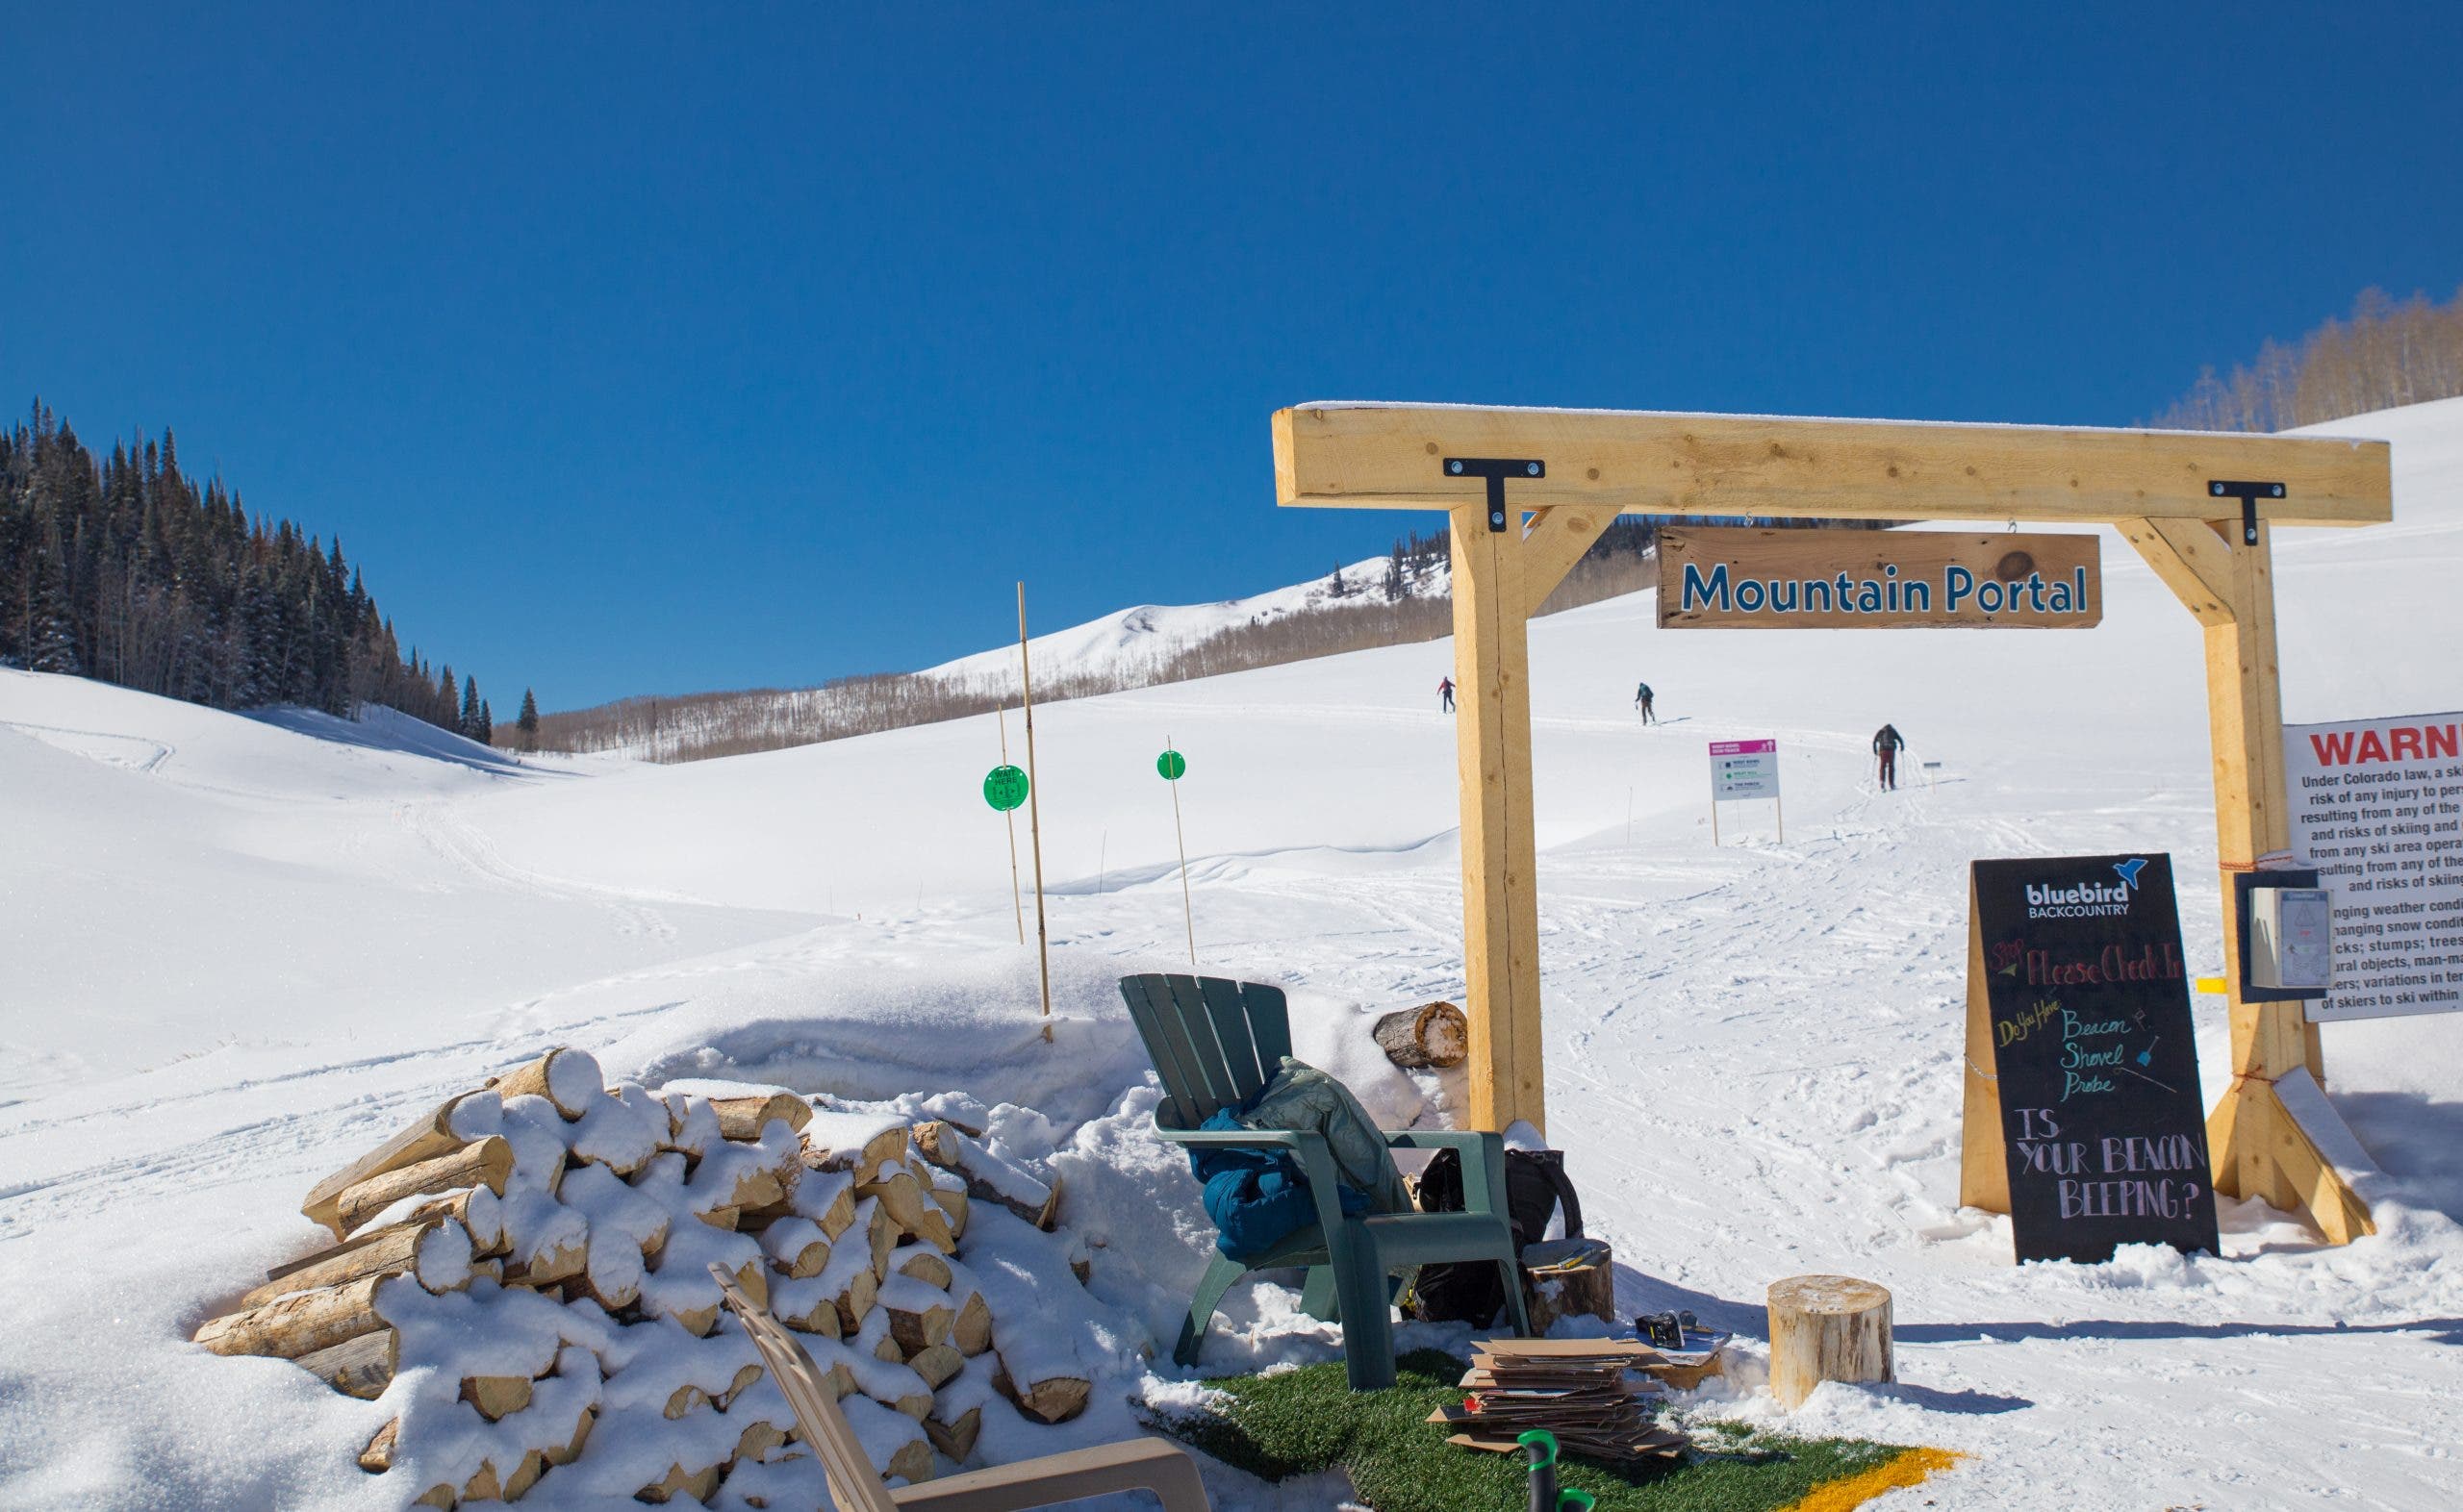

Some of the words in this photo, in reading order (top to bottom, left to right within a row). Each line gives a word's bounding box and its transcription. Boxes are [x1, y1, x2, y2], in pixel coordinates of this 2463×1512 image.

[1681, 563, 1931, 613] Mountain
[1944, 566, 2087, 614] Portal
[2310, 722, 2463, 767] WARN
[995, 769, 1015, 778] WAIT
[995, 777, 1017, 786] HERE
[2301, 775, 2339, 788] Under
[2344, 770, 2400, 785] Colorado
[2404, 769, 2431, 781] law,
[2434, 769, 2443, 778] a
[2310, 794, 2334, 805] risk
[2339, 791, 2351, 803] of
[2355, 791, 2377, 803] any
[2382, 787, 2419, 801] injury
[2423, 786, 2436, 797] to
[2301, 809, 2357, 824] resulting
[2361, 805, 2392, 819] from
[2396, 805, 2419, 819] any
[2423, 802, 2436, 815] of
[2439, 802, 2460, 814] the
[2311, 828, 2335, 841] and
[2339, 825, 2371, 840] risks
[2374, 823, 2388, 837] of
[2391, 821, 2430, 835] skiing
[2434, 819, 2458, 831] and
[2310, 846, 2340, 859] from
[2344, 845, 2366, 859] any
[2371, 842, 2390, 854] ski
[2394, 842, 2422, 853] area
[2317, 862, 2363, 876] sulting
[2367, 861, 2398, 873] from
[2401, 859, 2424, 871] any
[2427, 856, 2441, 869] of
[2444, 855, 2463, 868] the
[2026, 880, 2129, 905] bluebird
[2349, 879, 2373, 892] and
[2376, 876, 2409, 890] risks
[2412, 874, 2425, 887] of
[2029, 904, 2129, 919] BACKCOUNTRY
[2373, 901, 2425, 916] weather
[2387, 920, 2422, 932] snow
[2369, 938, 2425, 952] stumps;
[2027, 947, 2101, 986] Please
[2361, 956, 2411, 971] objects,
[2363, 972, 2426, 989] variations
[2430, 971, 2442, 983] in
[2321, 996, 2334, 1010] of
[2337, 994, 2376, 1009] skiers
[2379, 993, 2393, 1005] to
[2396, 990, 2416, 1004] ski
[2419, 989, 2459, 1003] within
[1997, 1021, 2019, 1047] Do
[2017, 1011, 2035, 1041] You
[2061, 1008, 2132, 1043] Beacon
[2060, 1043, 2123, 1070] Shovel
[2061, 1071, 2116, 1102] Probe
[2015, 1108, 2061, 1141] IS
[2017, 1142, 2091, 1175] YOUR
[2101, 1133, 2206, 1173] BEACON
[2058, 1178, 2200, 1221] BEEPING?
